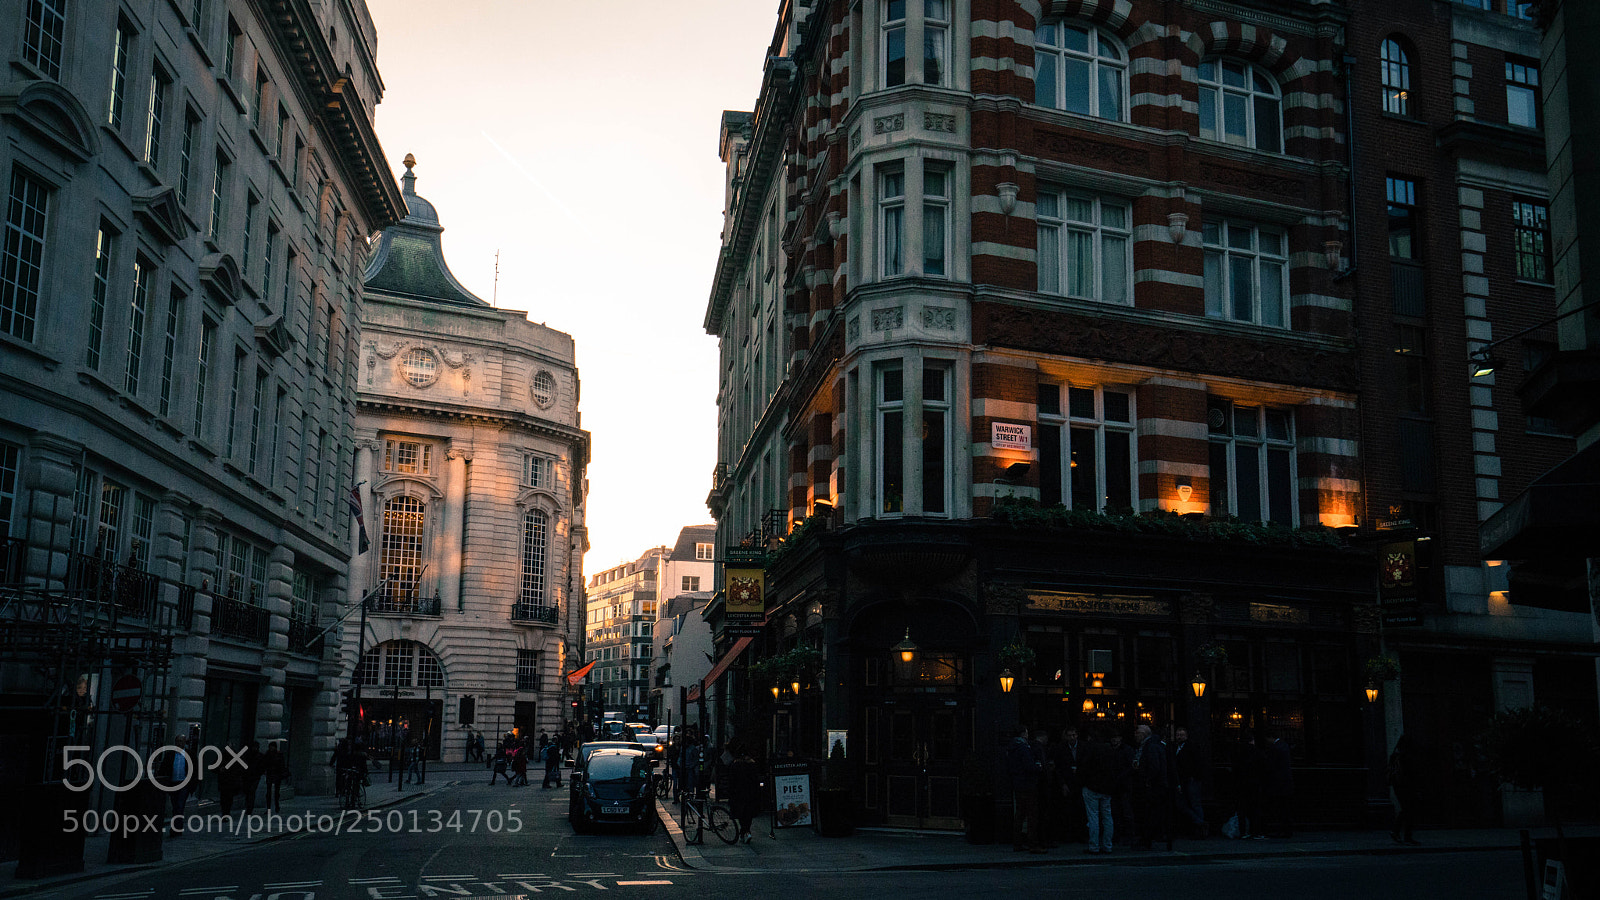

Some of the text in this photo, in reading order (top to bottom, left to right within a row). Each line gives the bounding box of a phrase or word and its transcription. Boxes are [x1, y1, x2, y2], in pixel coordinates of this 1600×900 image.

[995, 425, 1024, 435] WARWICK
[995, 434, 1018, 442] STREET
[783, 785, 803, 794] PIES
[367, 879, 609, 899] ENTRY
